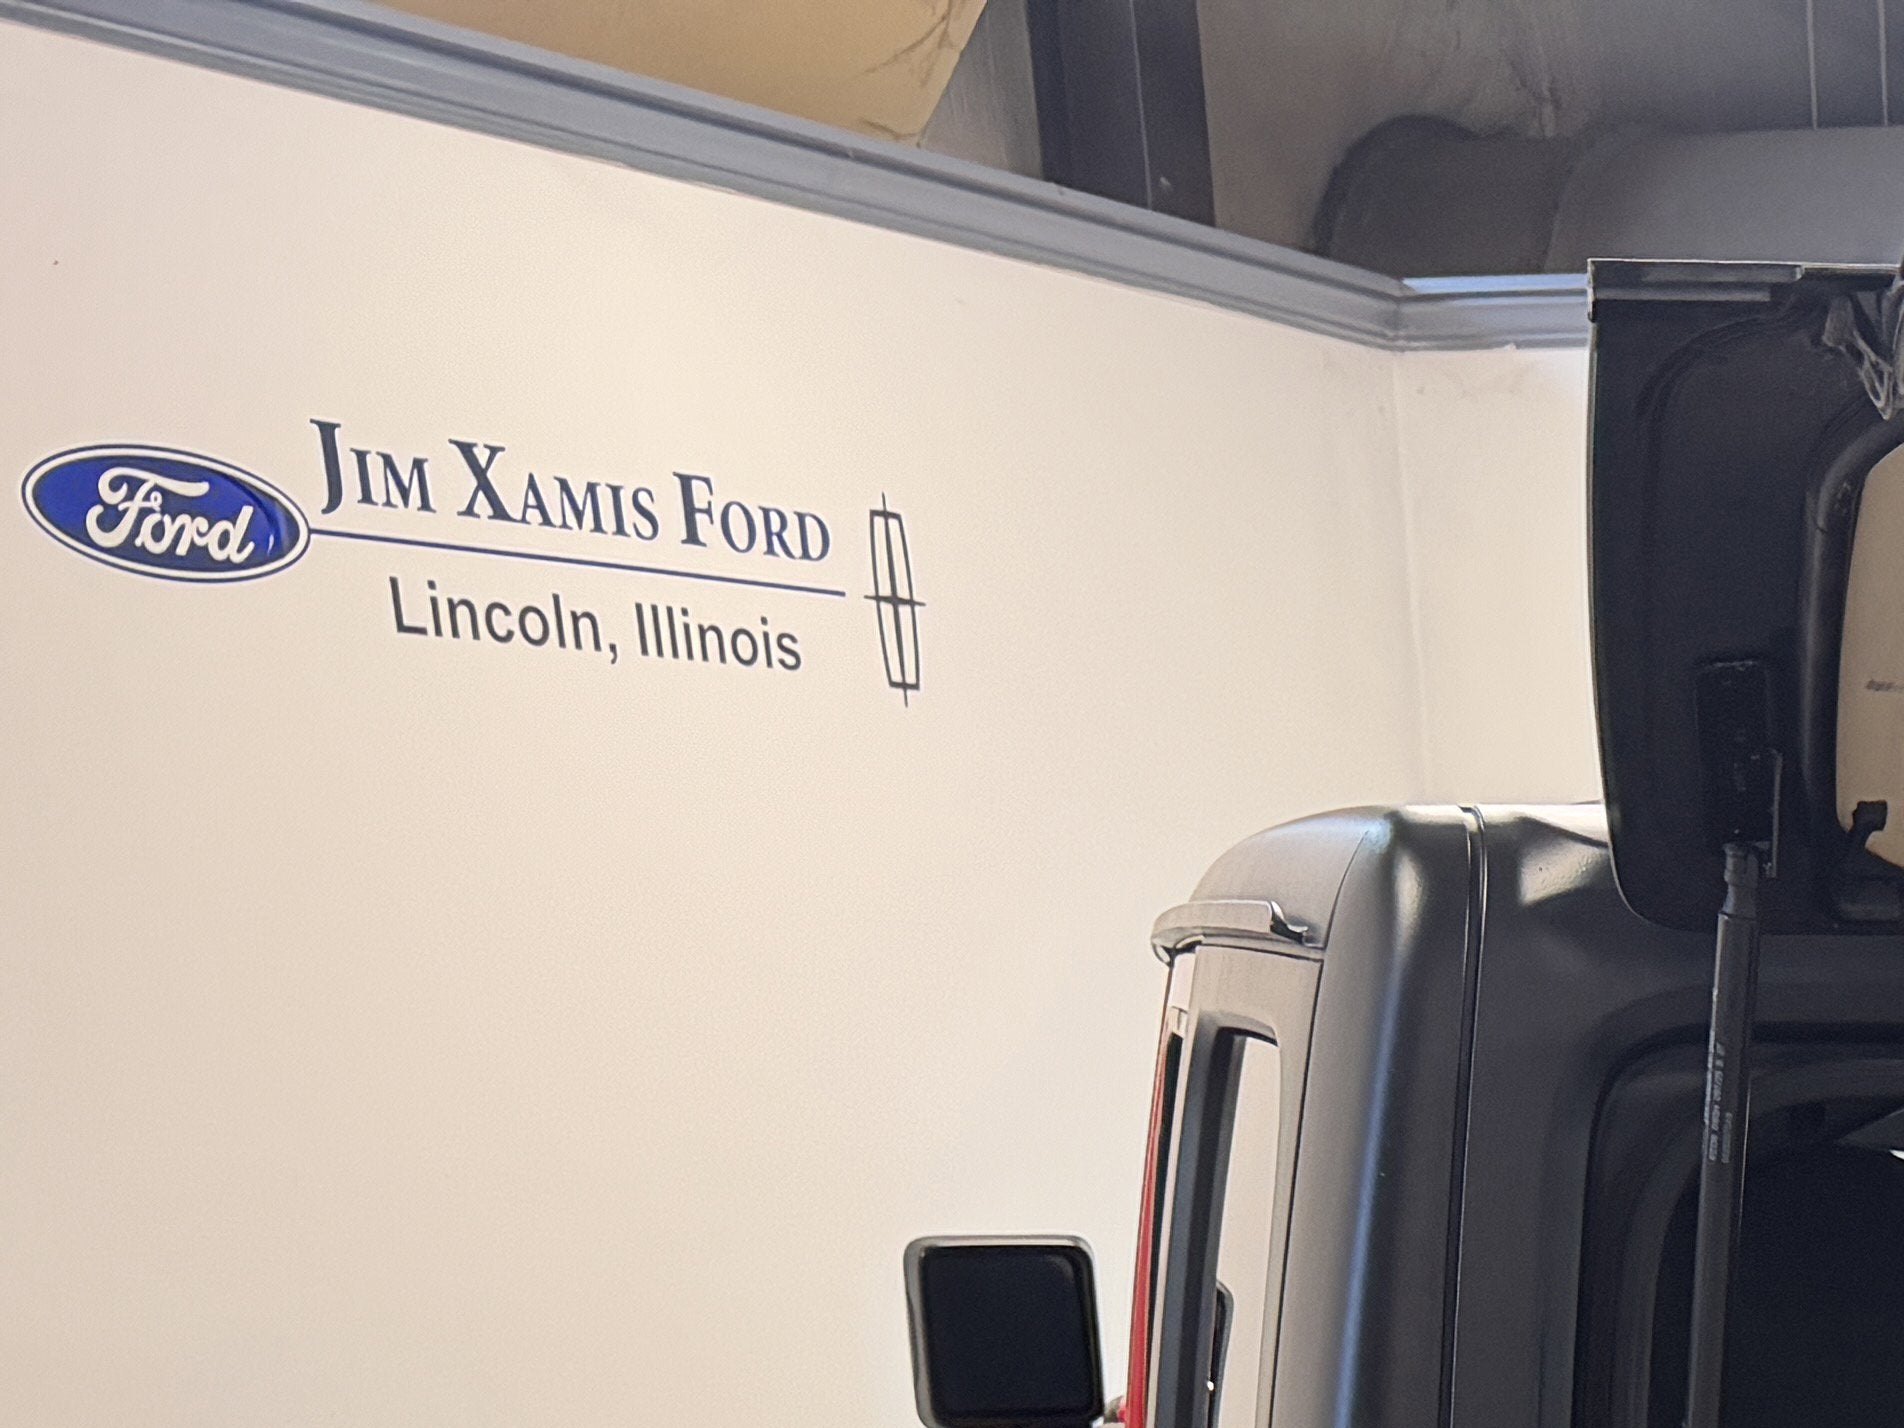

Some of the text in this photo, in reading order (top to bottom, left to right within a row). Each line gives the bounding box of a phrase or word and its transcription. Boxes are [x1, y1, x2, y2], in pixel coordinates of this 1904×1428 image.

[84, 467, 257, 566] Ford
[309, 419, 832, 563] JIM XAMIS FORD
[389, 576, 803, 673] Lincoln, Illinois
